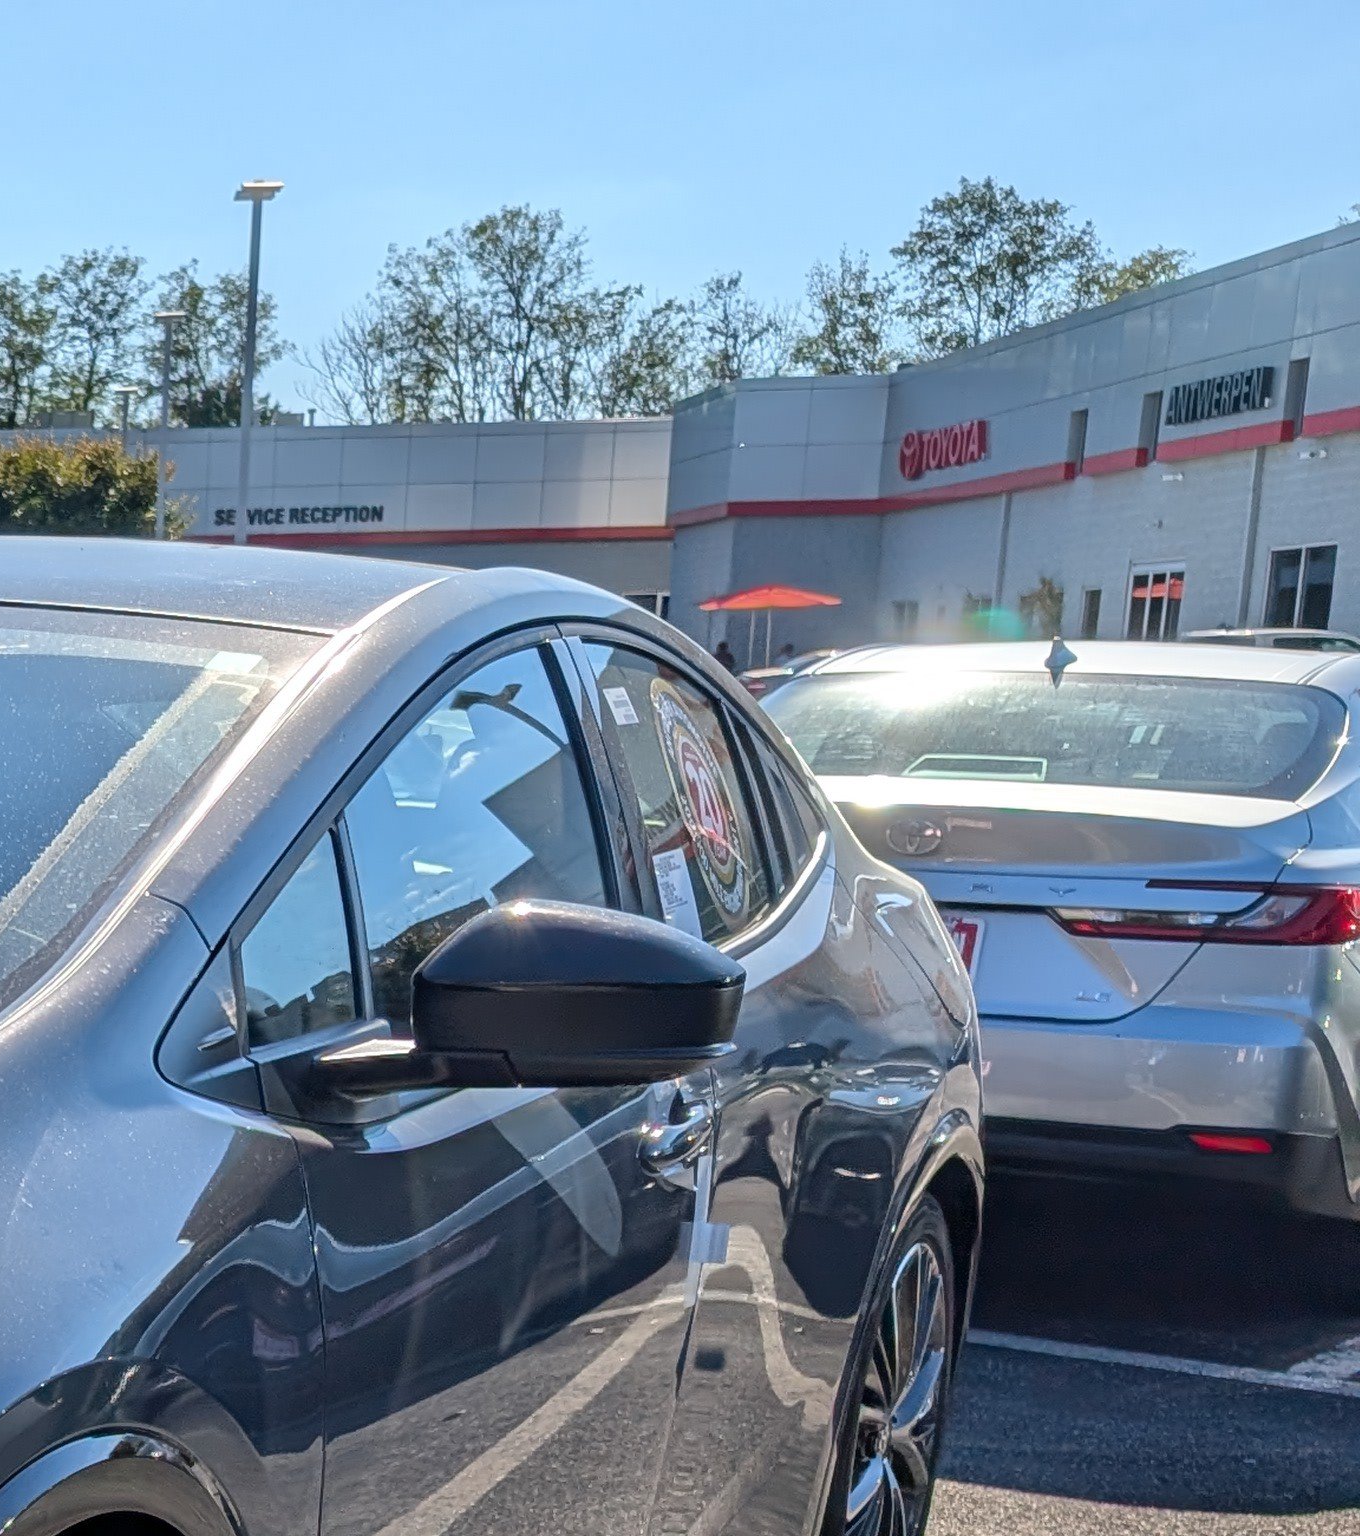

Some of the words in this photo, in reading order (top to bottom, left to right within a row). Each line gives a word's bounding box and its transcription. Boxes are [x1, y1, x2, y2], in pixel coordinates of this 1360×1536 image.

[1165, 366, 1268, 424] ANTWERPEN
[921, 420, 982, 472] TOYOTA
[214, 508, 285, 526] SEVICE
[289, 505, 384, 524] RECEPTION
